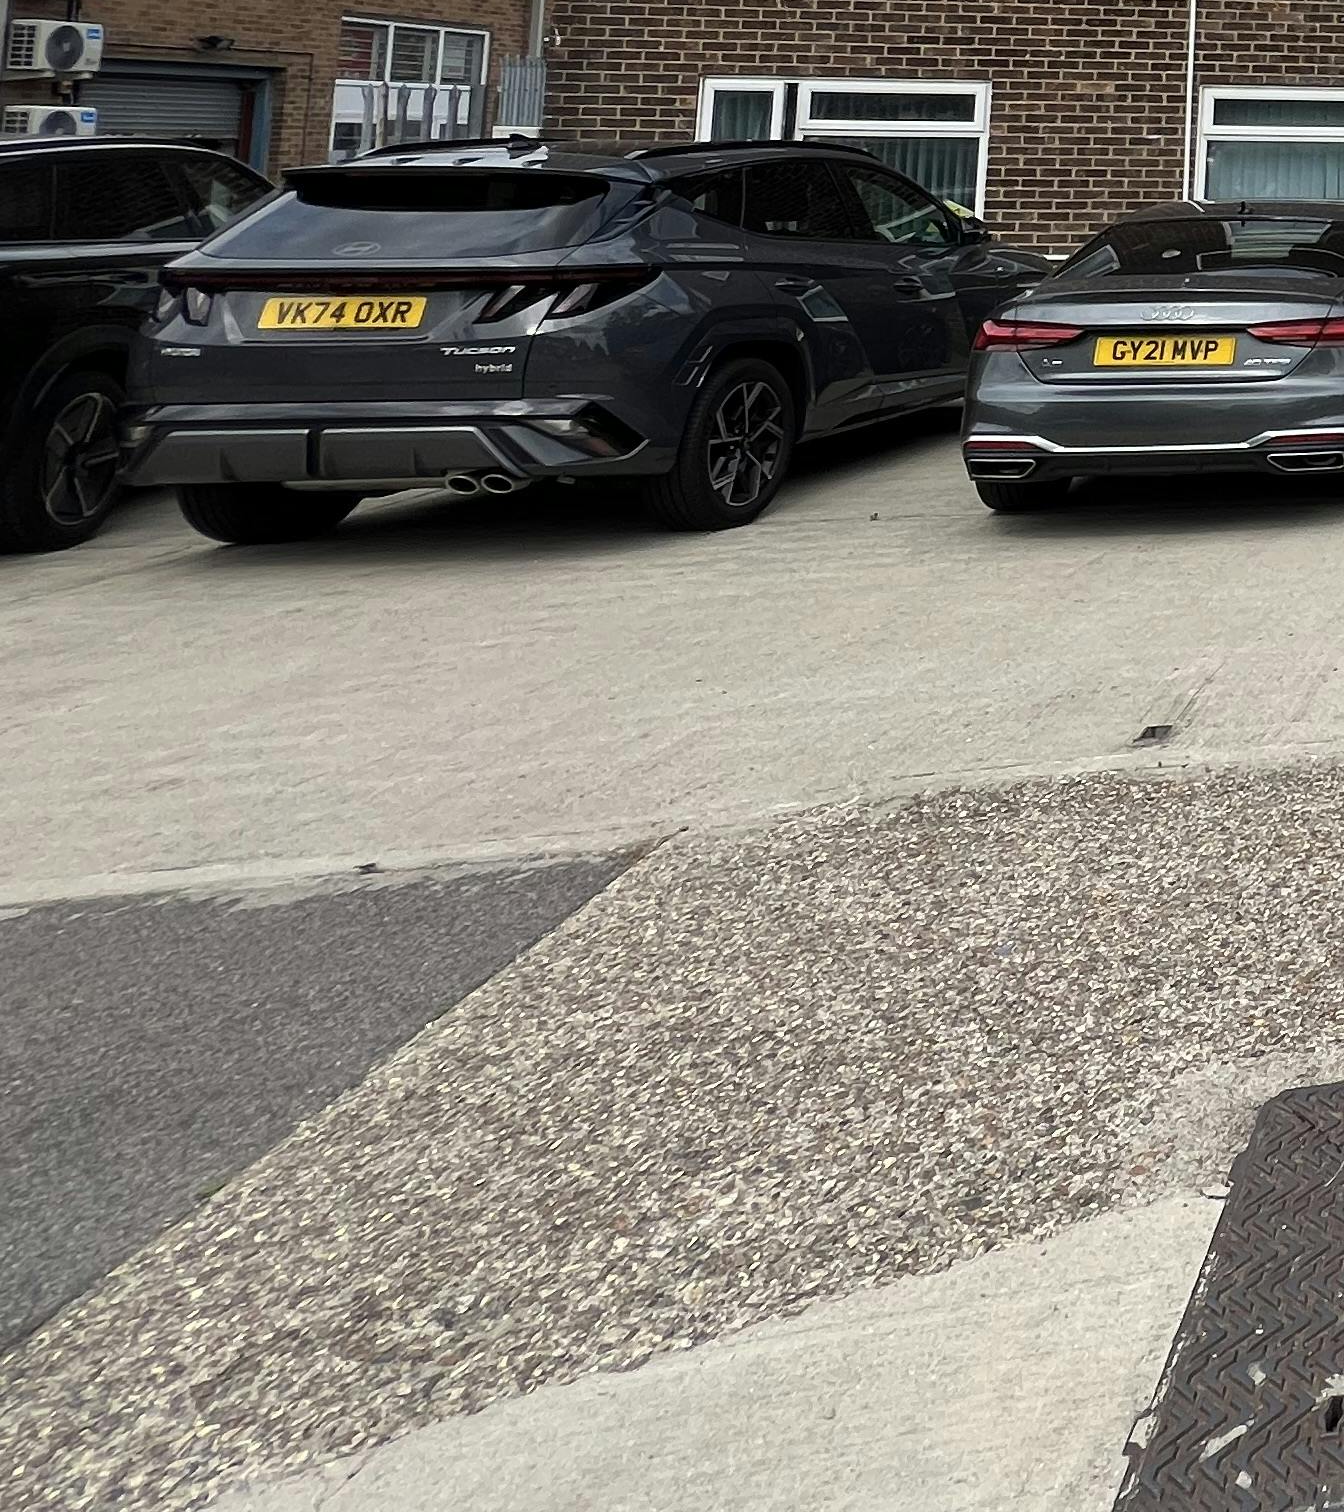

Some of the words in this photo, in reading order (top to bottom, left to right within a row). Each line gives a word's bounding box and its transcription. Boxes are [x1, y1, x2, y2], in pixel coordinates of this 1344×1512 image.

[277, 302, 348, 324] VK74
[353, 302, 413, 323] OXR
[1112, 340, 1167, 361] GY21
[1171, 339, 1219, 360] MVP
[475, 364, 513, 374] hybrid
